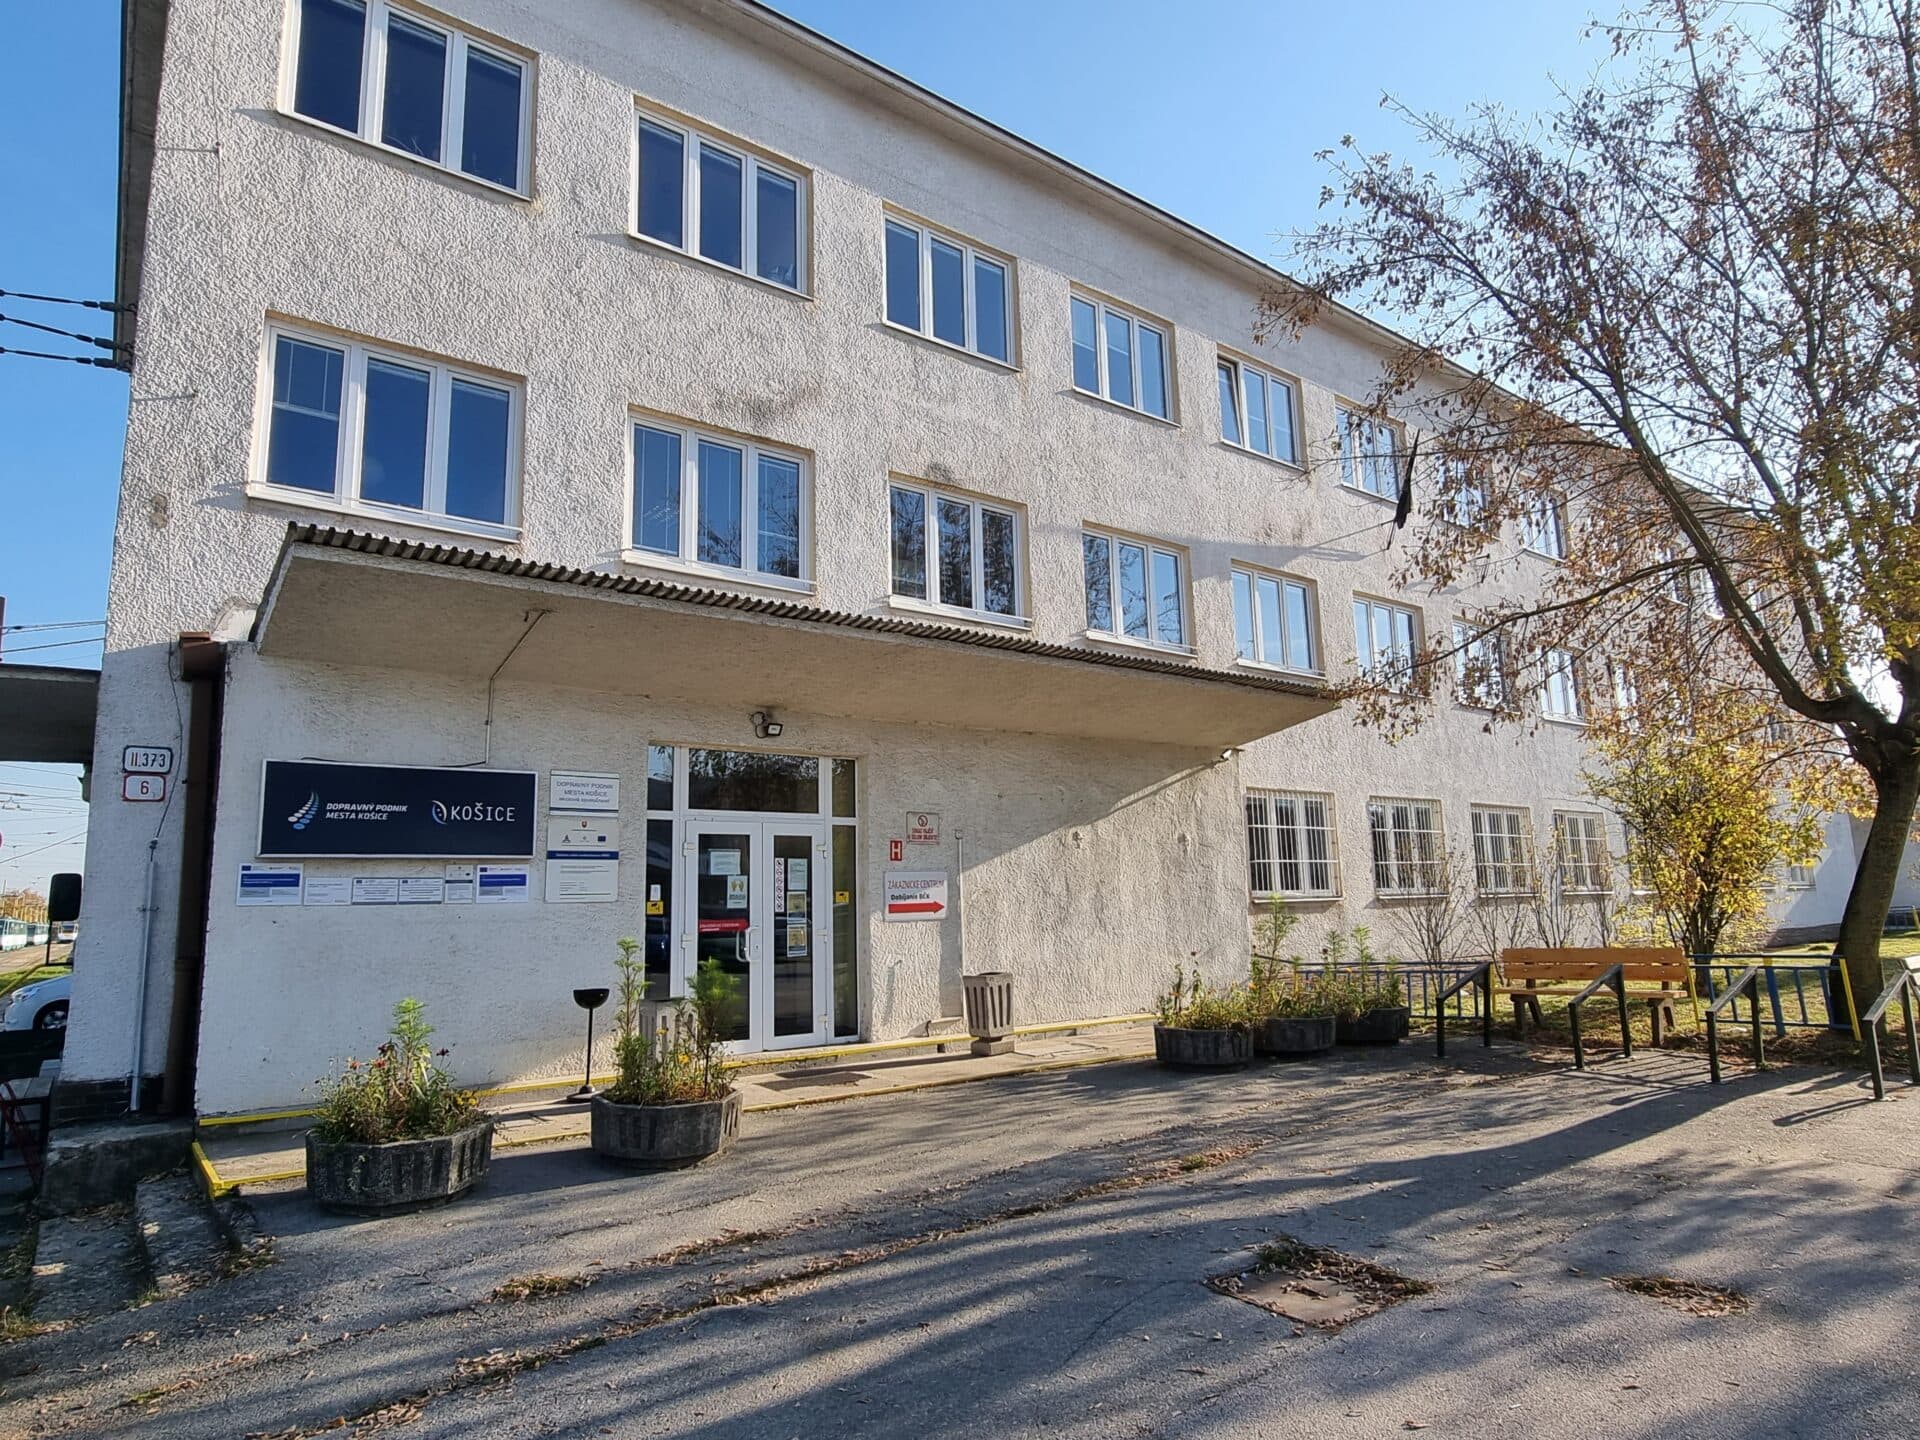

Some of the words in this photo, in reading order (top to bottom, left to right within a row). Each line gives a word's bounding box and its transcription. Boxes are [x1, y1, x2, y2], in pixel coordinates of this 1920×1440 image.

[131, 751, 166, 767] II.373
[140, 780, 150, 795] 6
[326, 802, 375, 811] DOPRAVNÝ
[375, 804, 408, 812] PODNIK
[450, 802, 516, 822] KOŠICE
[325, 811, 356, 819] MESTA
[357, 811, 388, 821] KOŠICE
